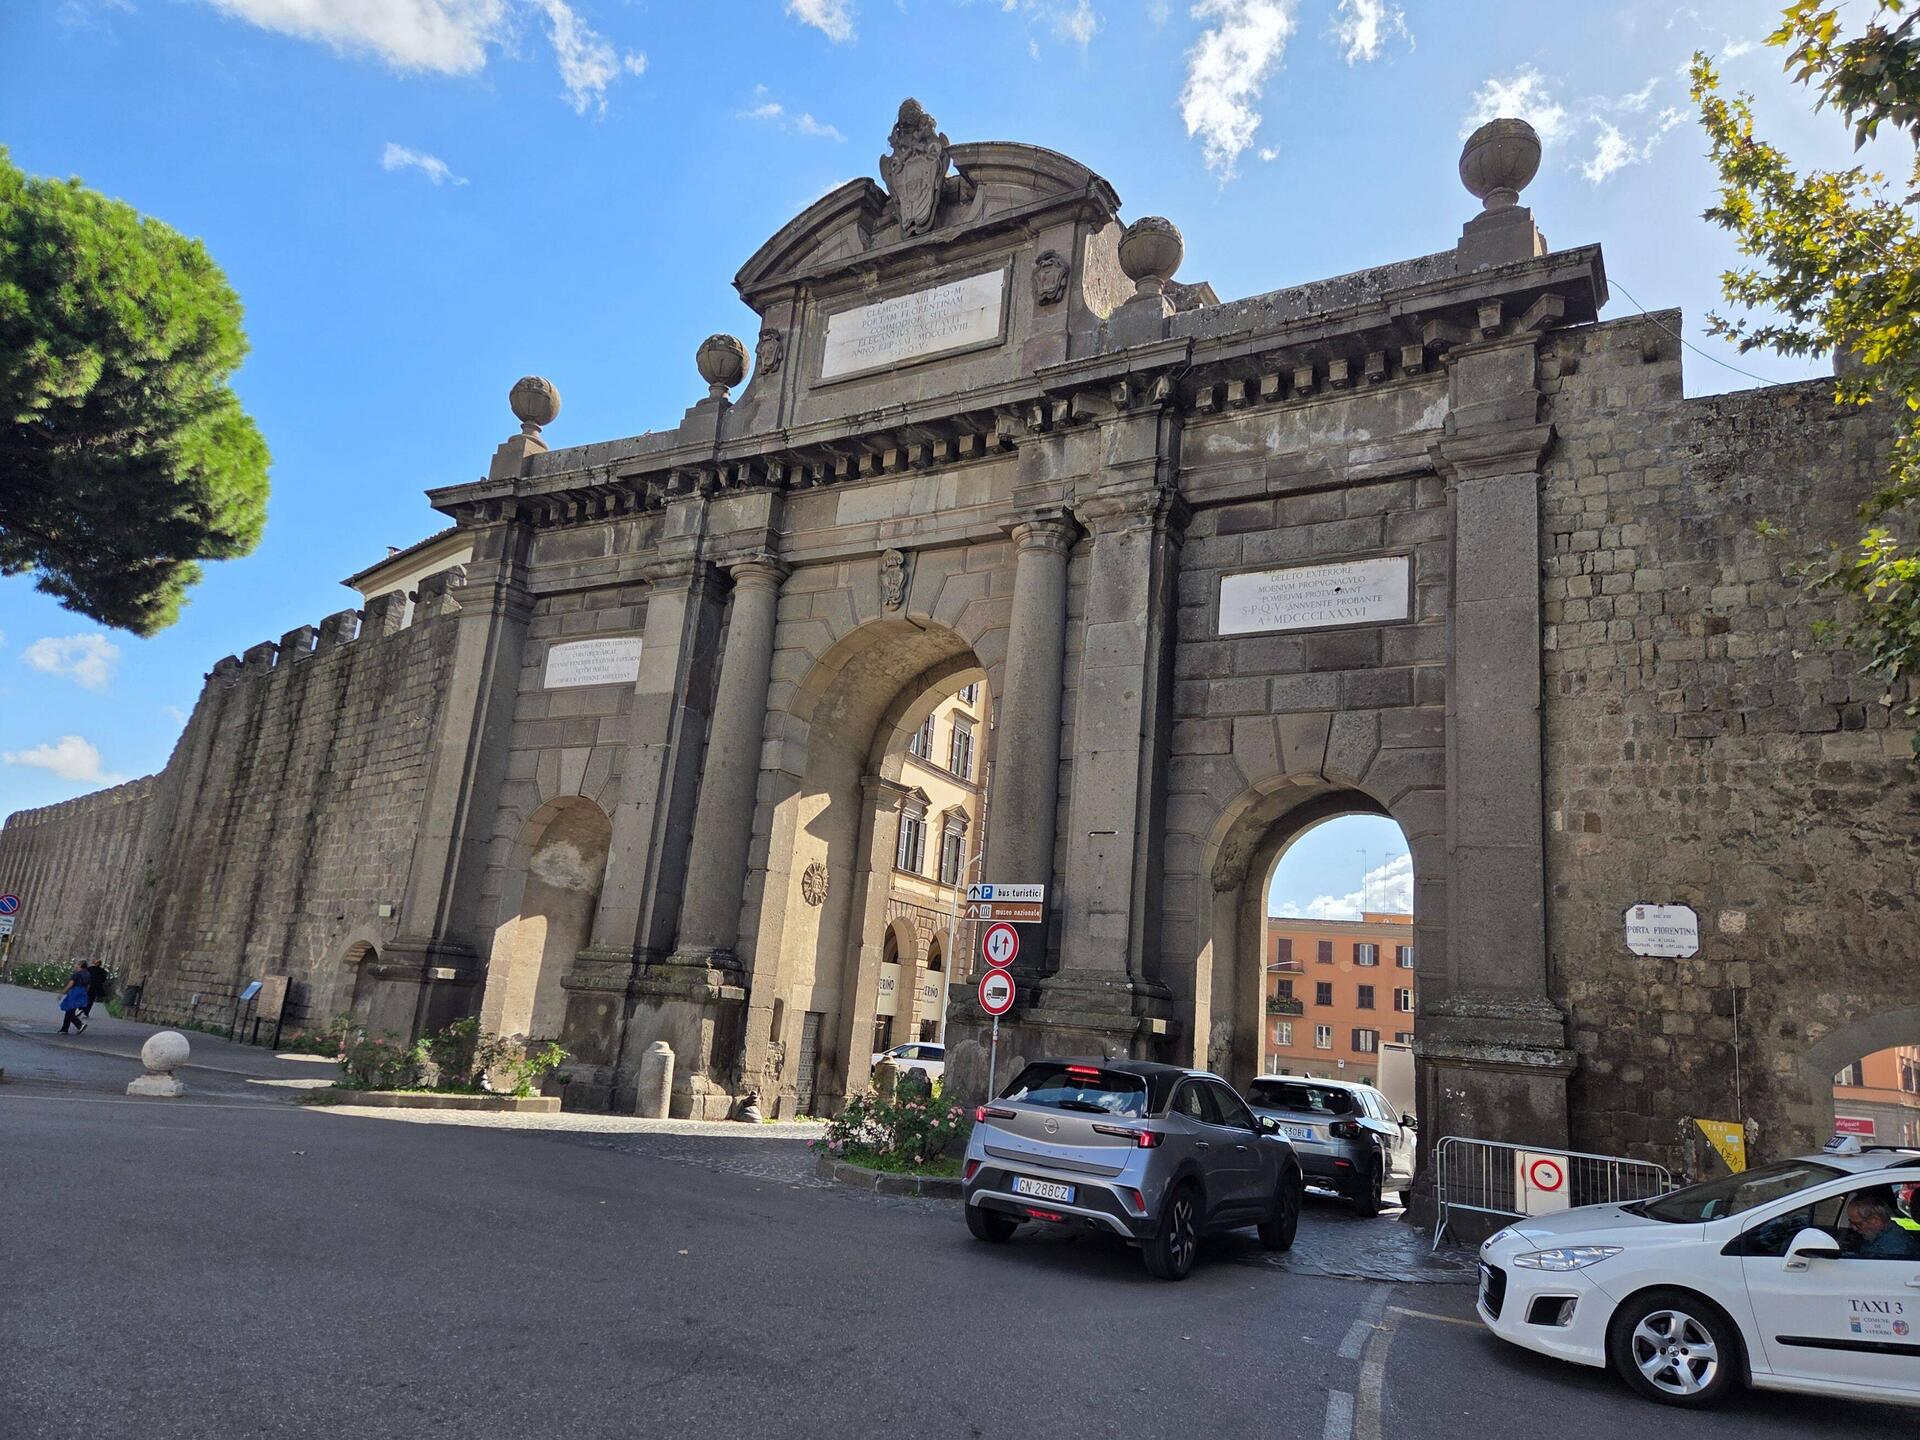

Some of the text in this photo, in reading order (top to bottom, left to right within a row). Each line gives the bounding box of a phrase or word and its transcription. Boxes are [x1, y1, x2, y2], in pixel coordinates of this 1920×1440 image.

[866, 300, 910, 318] CLEMENTE
[862, 313, 897, 328] PORTAM
[1272, 566, 1353, 582] DELETO EXTERIORE
[1258, 575, 1366, 593] MOENIVM PROPVGNACVLO
[1274, 606, 1366, 625] MDCCCLXXXVI
[998, 888, 1010, 897] bus
[1012, 888, 1042, 897] turistici
[1014, 908, 1040, 916] nazionale
[1627, 926, 1696, 936] PORTA FIORENTINA
[1019, 1179, 1068, 1200] GN 288CZ
[1848, 1299, 1904, 1314] TAXI 3
